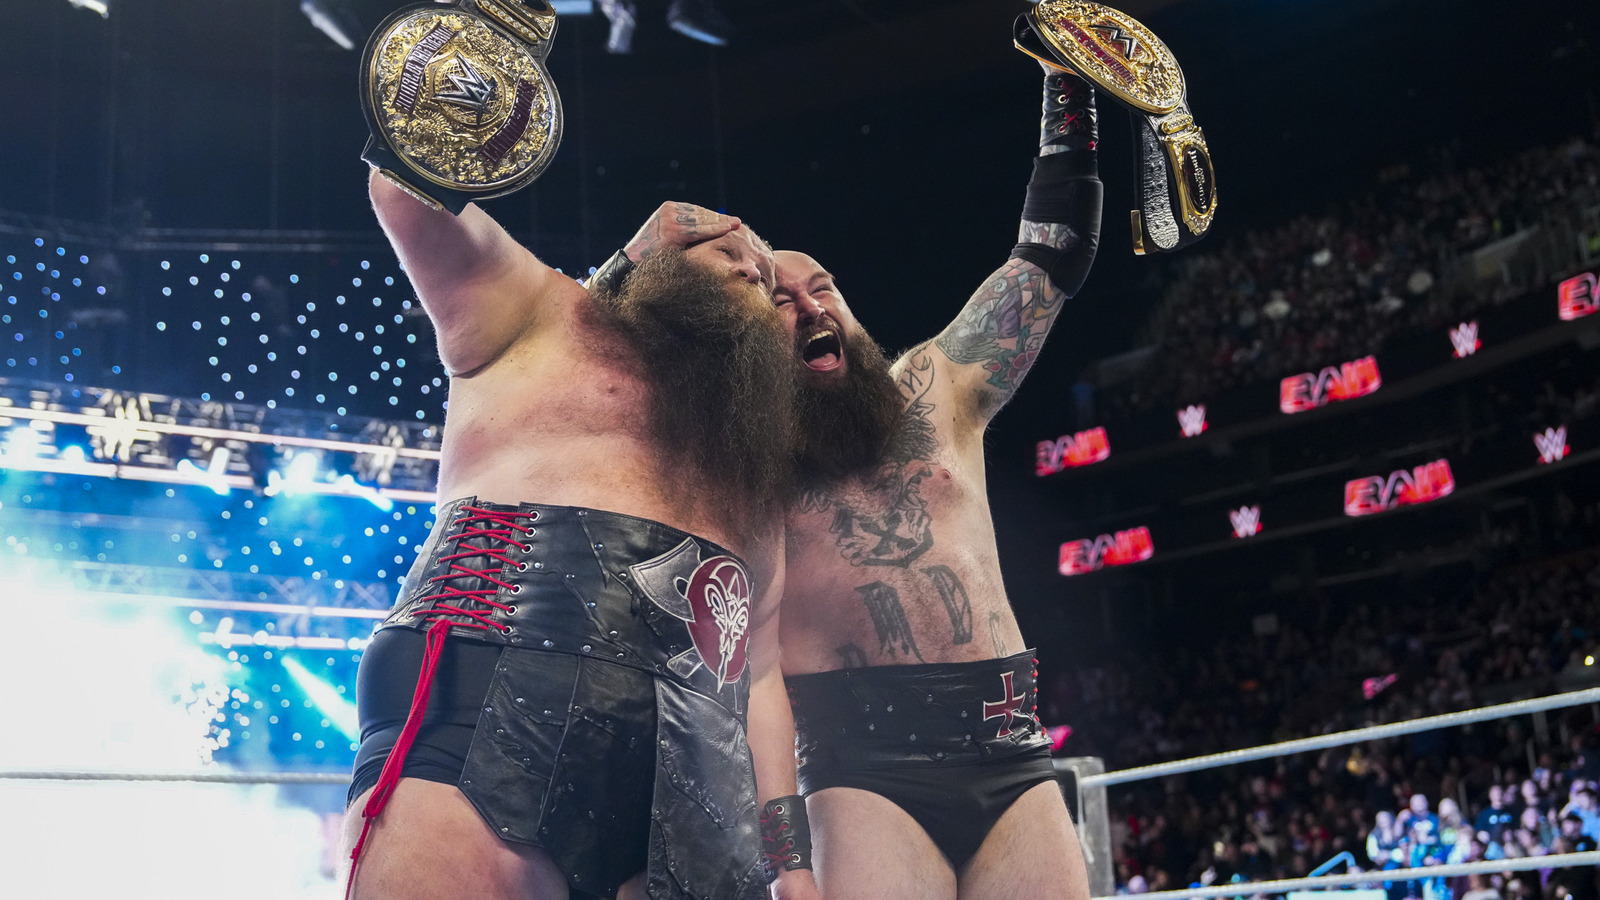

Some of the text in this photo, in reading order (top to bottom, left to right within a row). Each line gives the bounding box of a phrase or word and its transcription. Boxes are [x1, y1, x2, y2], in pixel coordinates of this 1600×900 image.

[396, 61, 423, 111] WORLD
[1280, 356, 1382, 413] RAW
[1036, 427, 1111, 476] RAW
[1345, 459, 1455, 516] RAW
[1059, 526, 1155, 576] RAW
